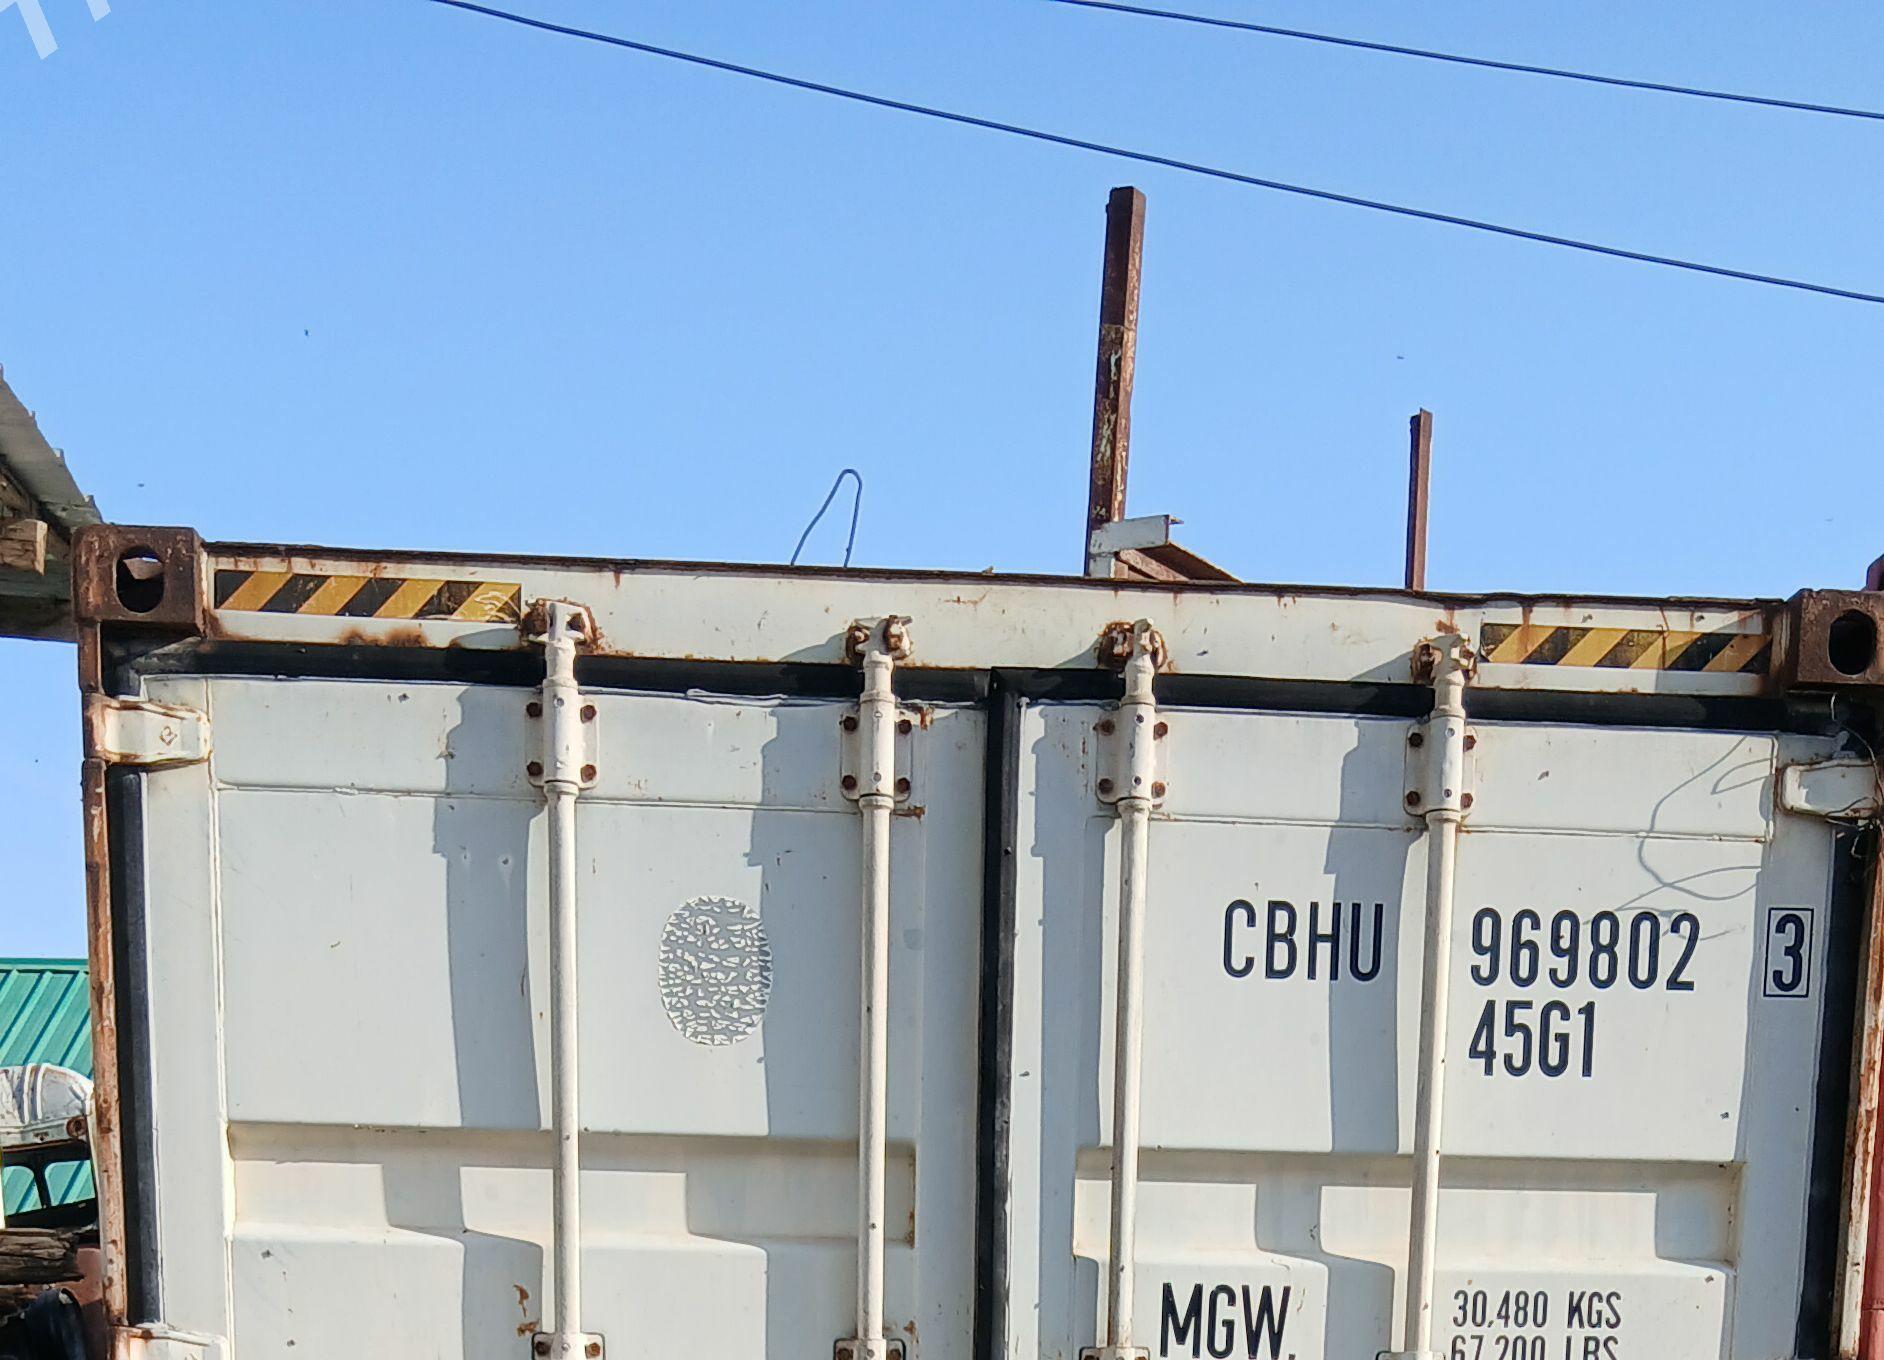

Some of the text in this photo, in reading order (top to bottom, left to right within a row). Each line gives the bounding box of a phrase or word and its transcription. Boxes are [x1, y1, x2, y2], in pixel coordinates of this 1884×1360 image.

[1221, 899, 1805, 993] CBHU 969802 3
[1467, 999, 1596, 1078] 45G1
[1453, 1290, 1548, 1328] 30,480
[1567, 1291, 1622, 1329] KGS
